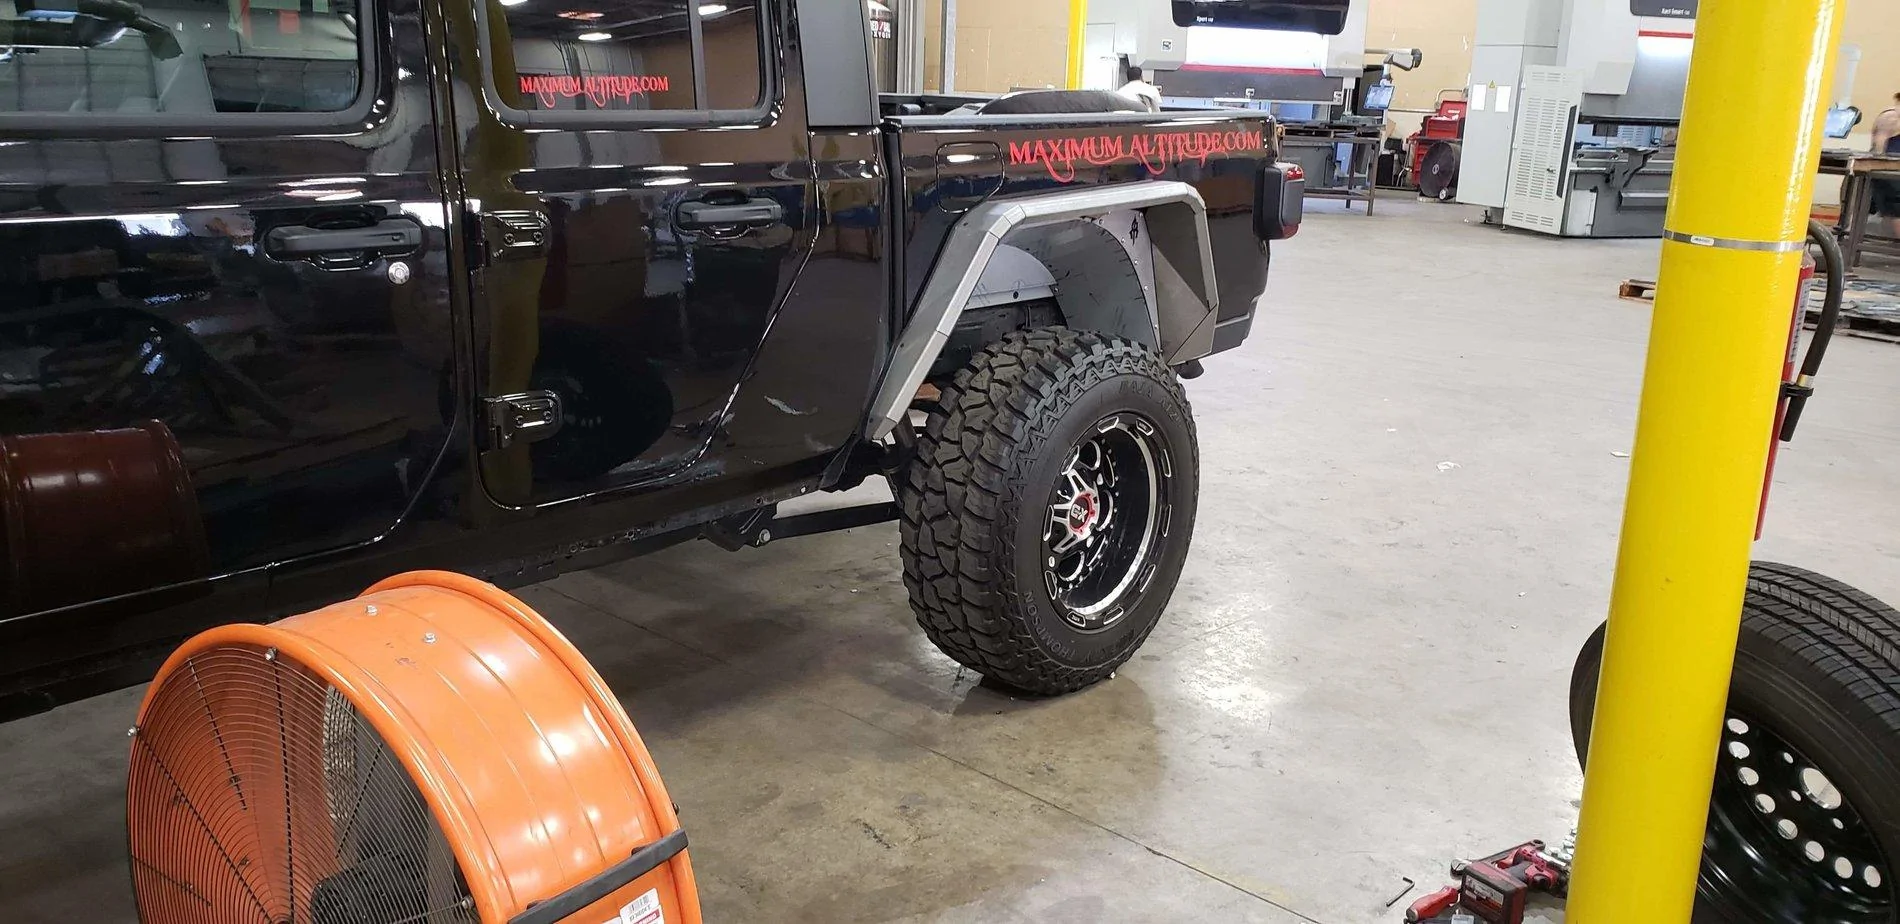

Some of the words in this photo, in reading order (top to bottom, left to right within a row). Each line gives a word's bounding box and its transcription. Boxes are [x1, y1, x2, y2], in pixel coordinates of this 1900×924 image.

[520, 75, 581, 108] MAXIMUM
[583, 75, 669, 108] ALTITUDE.COM
[1009, 135, 1123, 183] MAXIMUM
[1129, 131, 1262, 176] ALTITUDE.COM
[1023, 591, 1078, 661] THOMPSON
